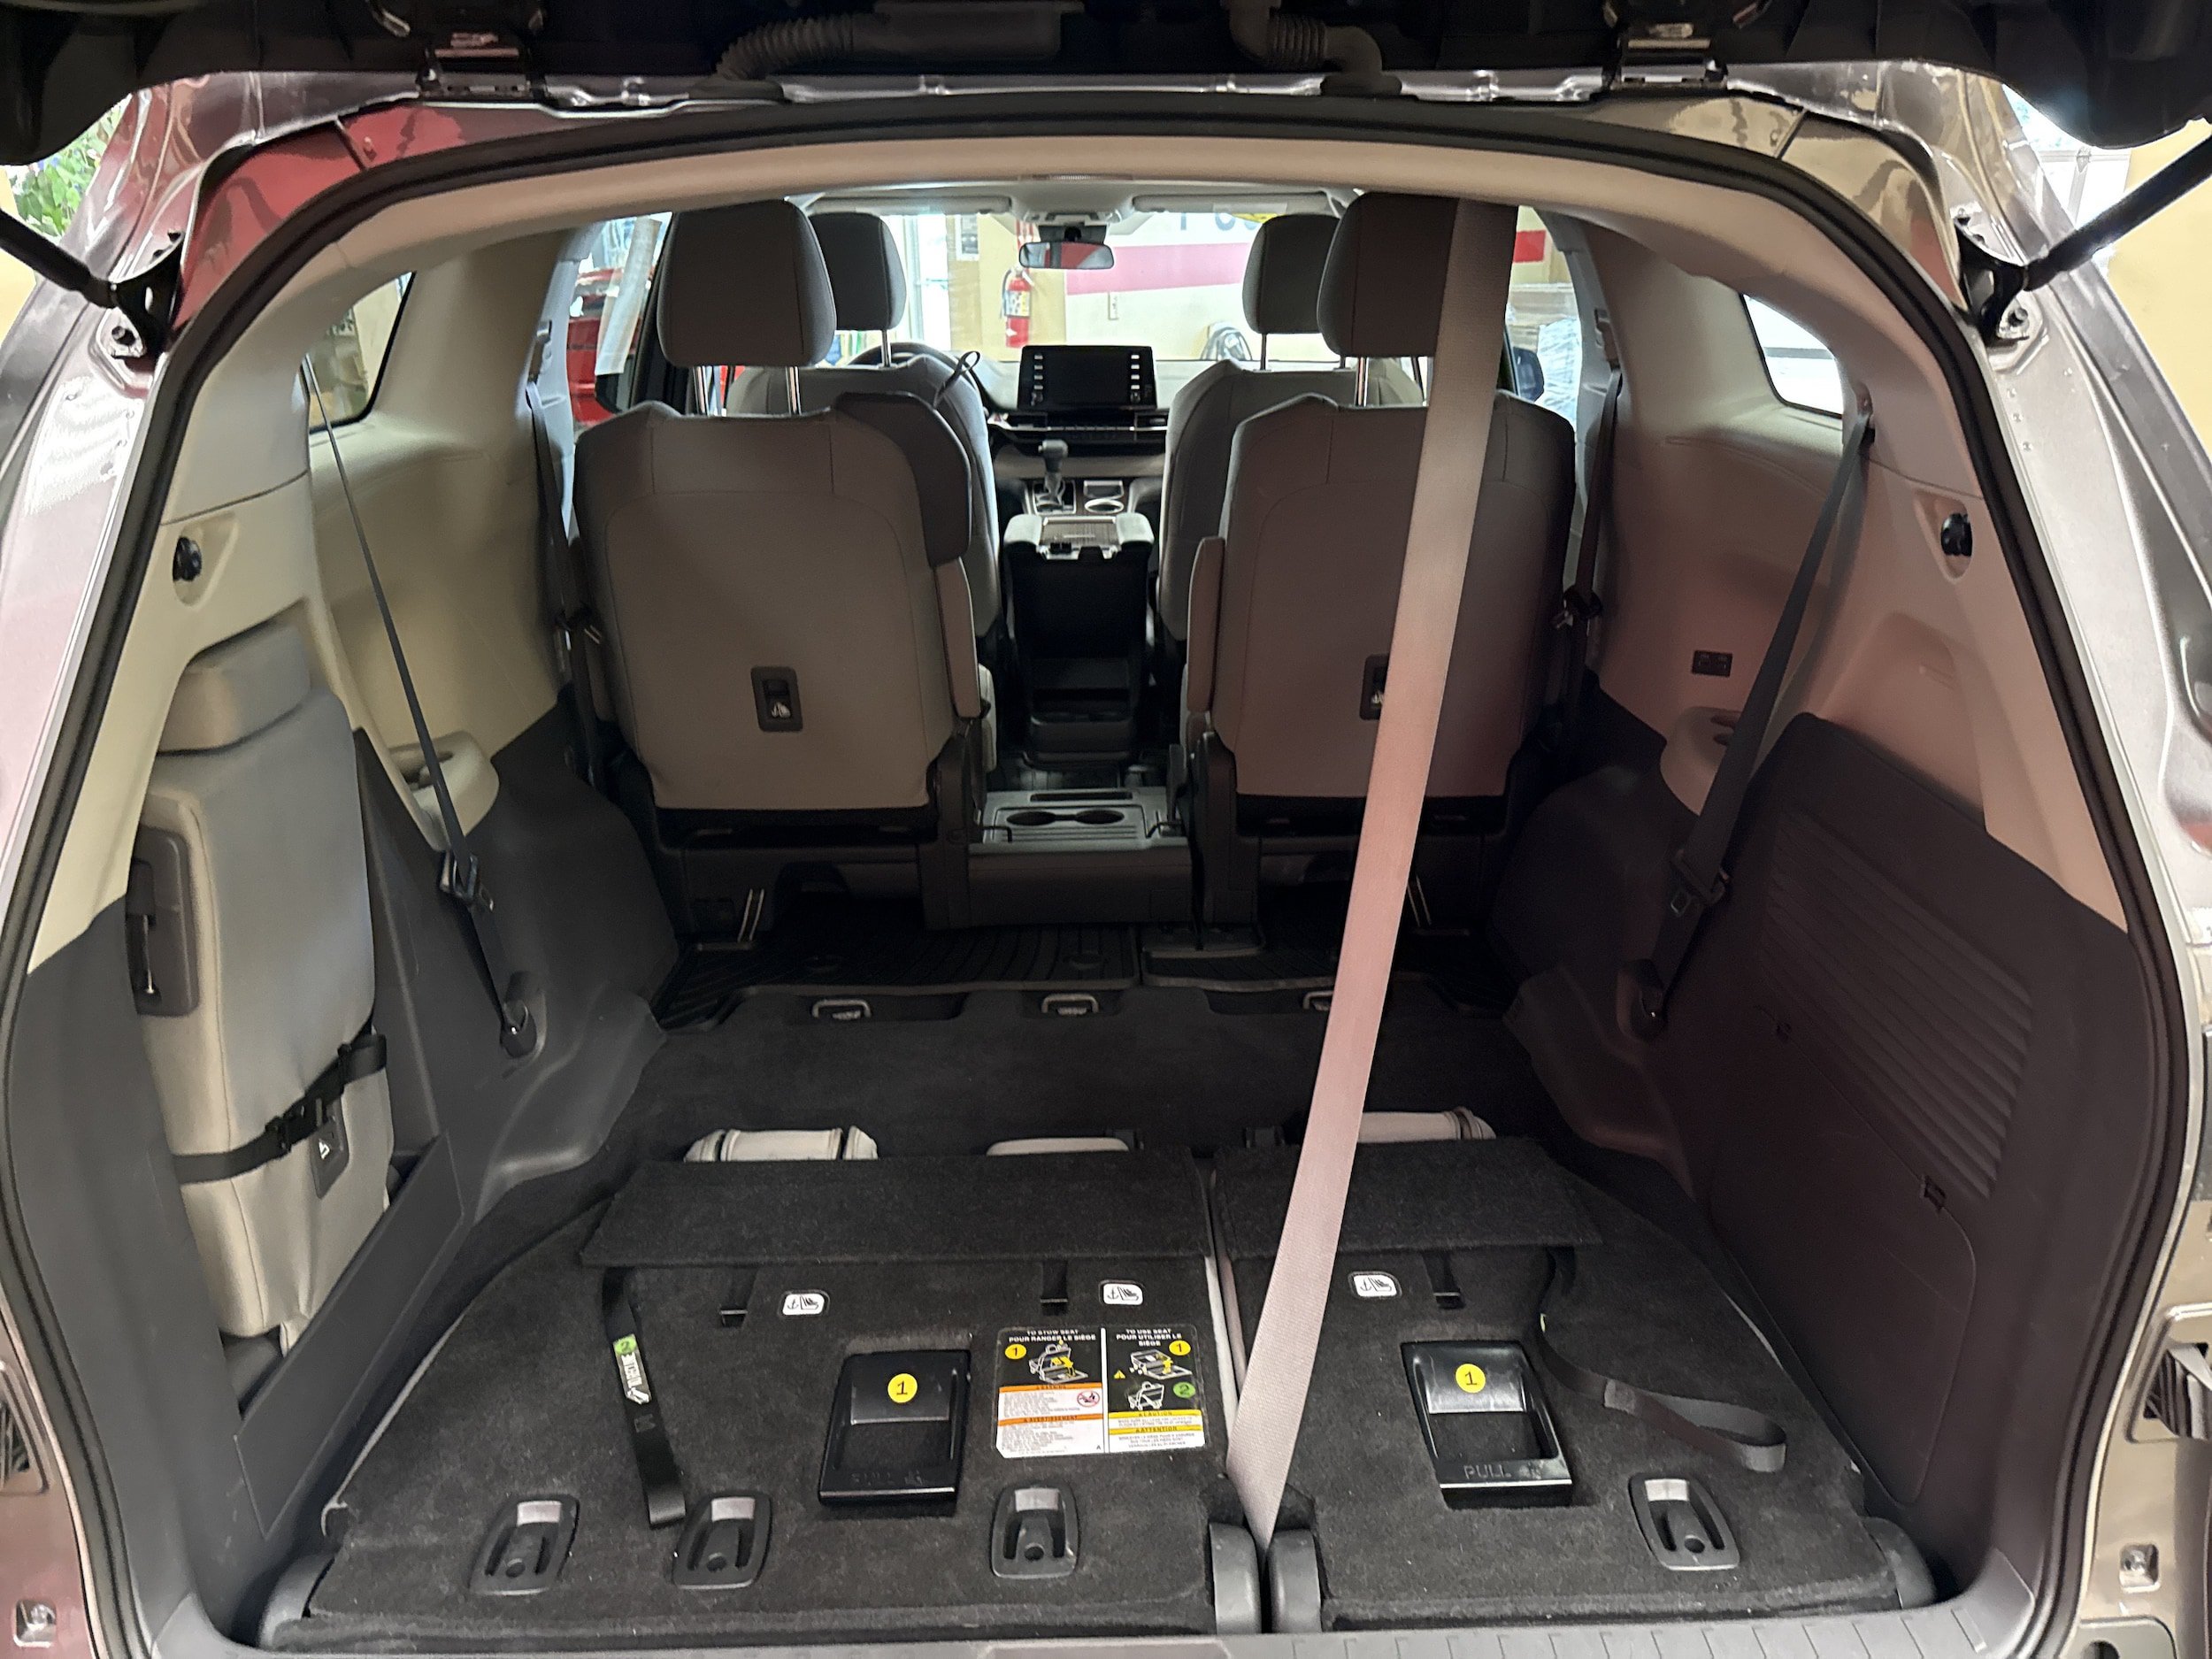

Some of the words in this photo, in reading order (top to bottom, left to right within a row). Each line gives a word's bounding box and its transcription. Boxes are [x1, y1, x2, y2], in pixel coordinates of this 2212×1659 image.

[620, 1340, 632, 1352] 2
[1465, 1371, 1478, 1386] 1
[896, 1380, 908, 1395] 1
[1179, 1384, 1190, 1395] 2
[1463, 1463, 1512, 1480] PULL
